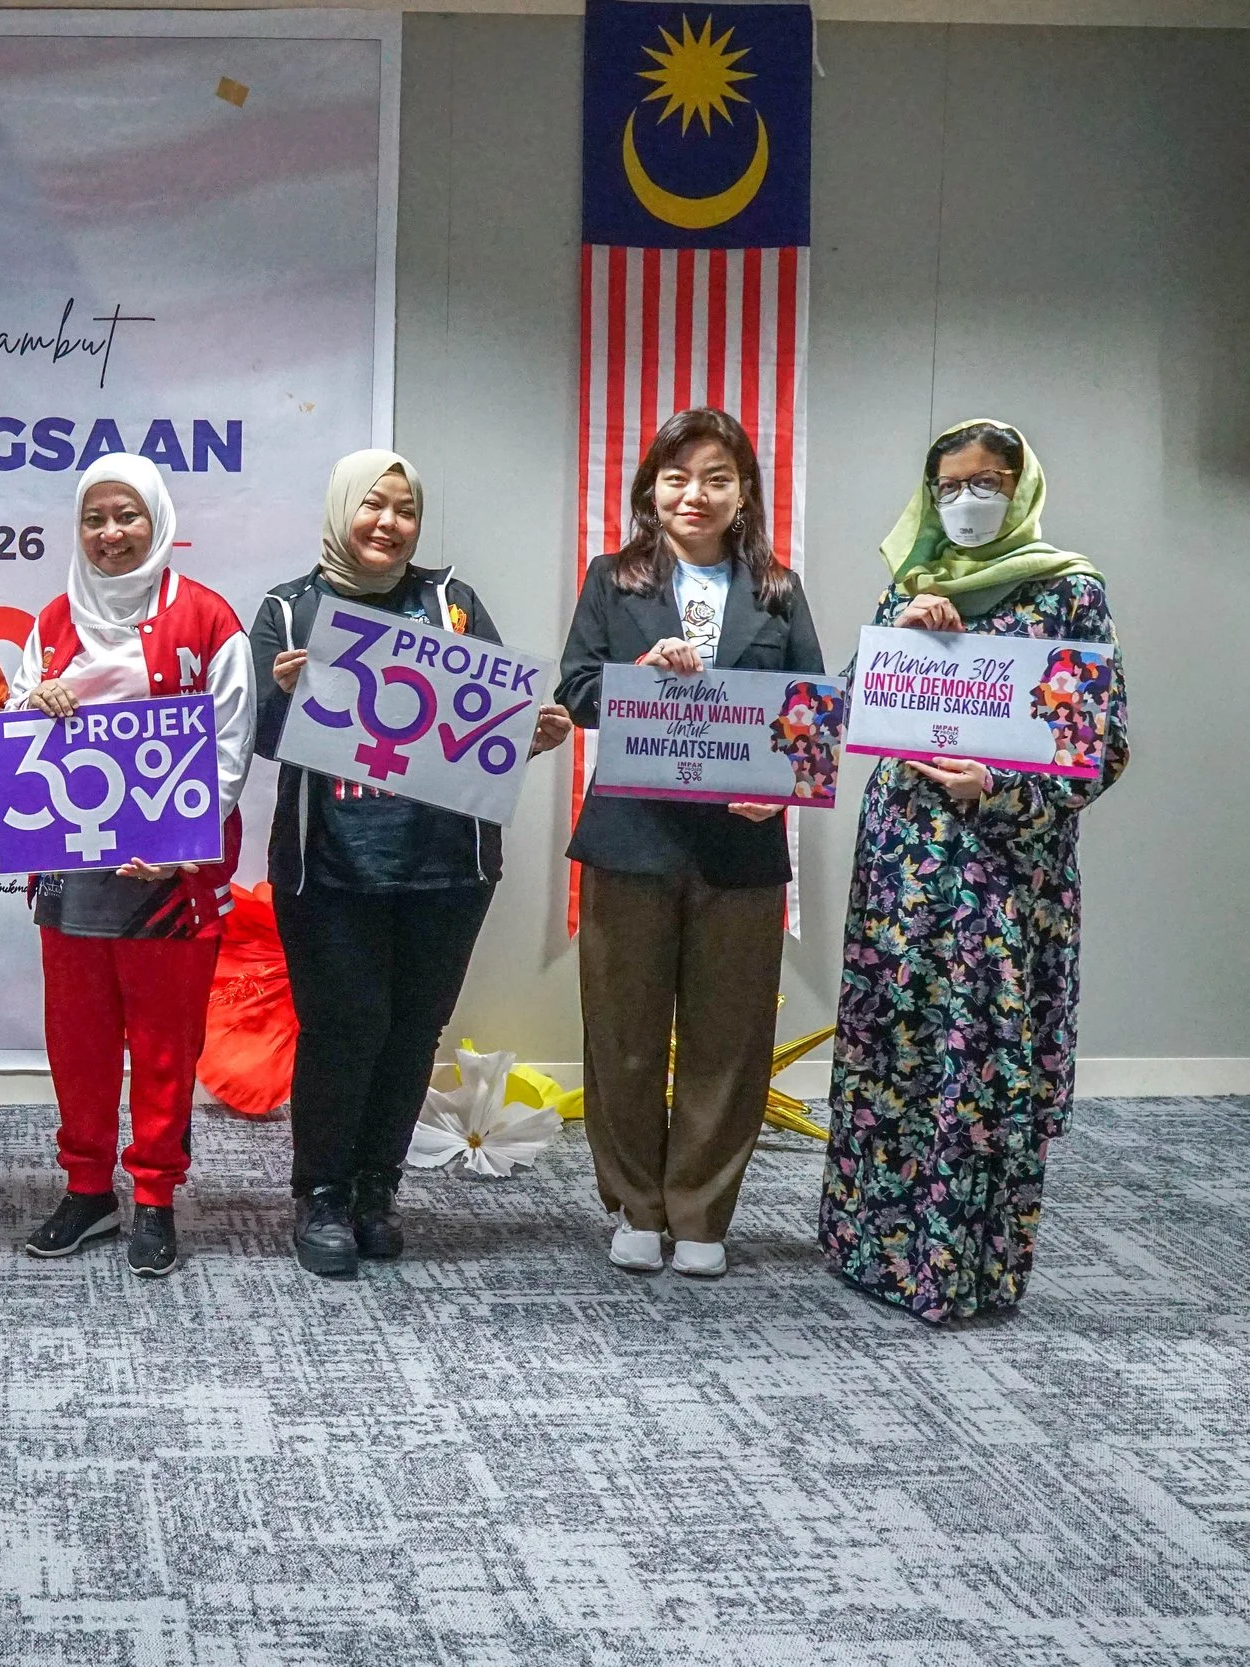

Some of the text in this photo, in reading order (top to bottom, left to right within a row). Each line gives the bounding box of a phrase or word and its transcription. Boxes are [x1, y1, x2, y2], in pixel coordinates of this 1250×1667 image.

[392, 629, 540, 697] PROJEK
[870, 650, 1015, 683] Minima 30%
[301, 610, 532, 780] 30%
[654, 677, 729, 704] Tambah
[864, 672, 1014, 702] UNTUK DEMOKRASI
[607, 699, 765, 725] PERWAKILAN WANITA
[863, 690, 1011, 718] YANG LEBIH SAKSAMA
[64, 705, 207, 744] PROJEK
[625, 736, 751, 762] MANFAATSEMUA
[2, 720, 212, 862] 30%
